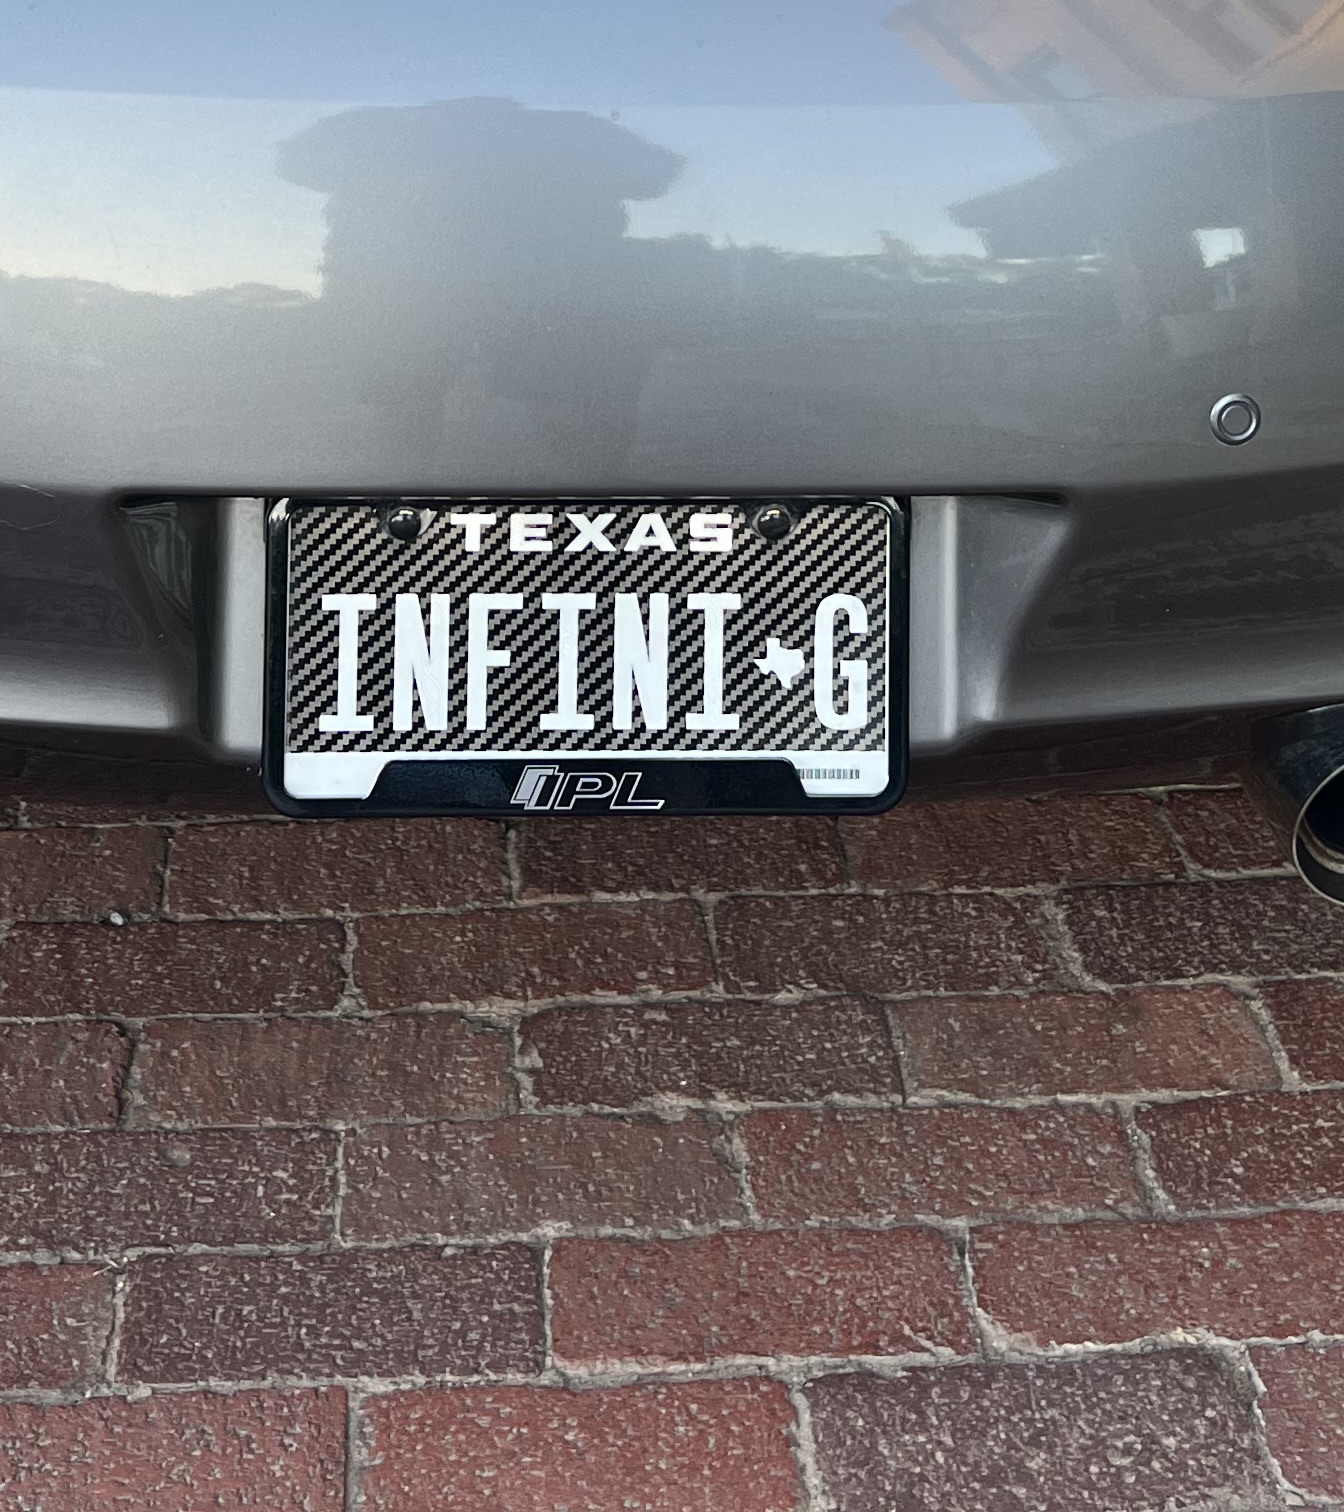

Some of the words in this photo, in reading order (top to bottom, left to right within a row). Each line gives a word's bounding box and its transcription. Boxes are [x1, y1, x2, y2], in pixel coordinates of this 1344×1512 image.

[451, 513, 734, 553] TEXAS
[318, 592, 741, 732] INFINI
[510, 765, 665, 810] IPL
